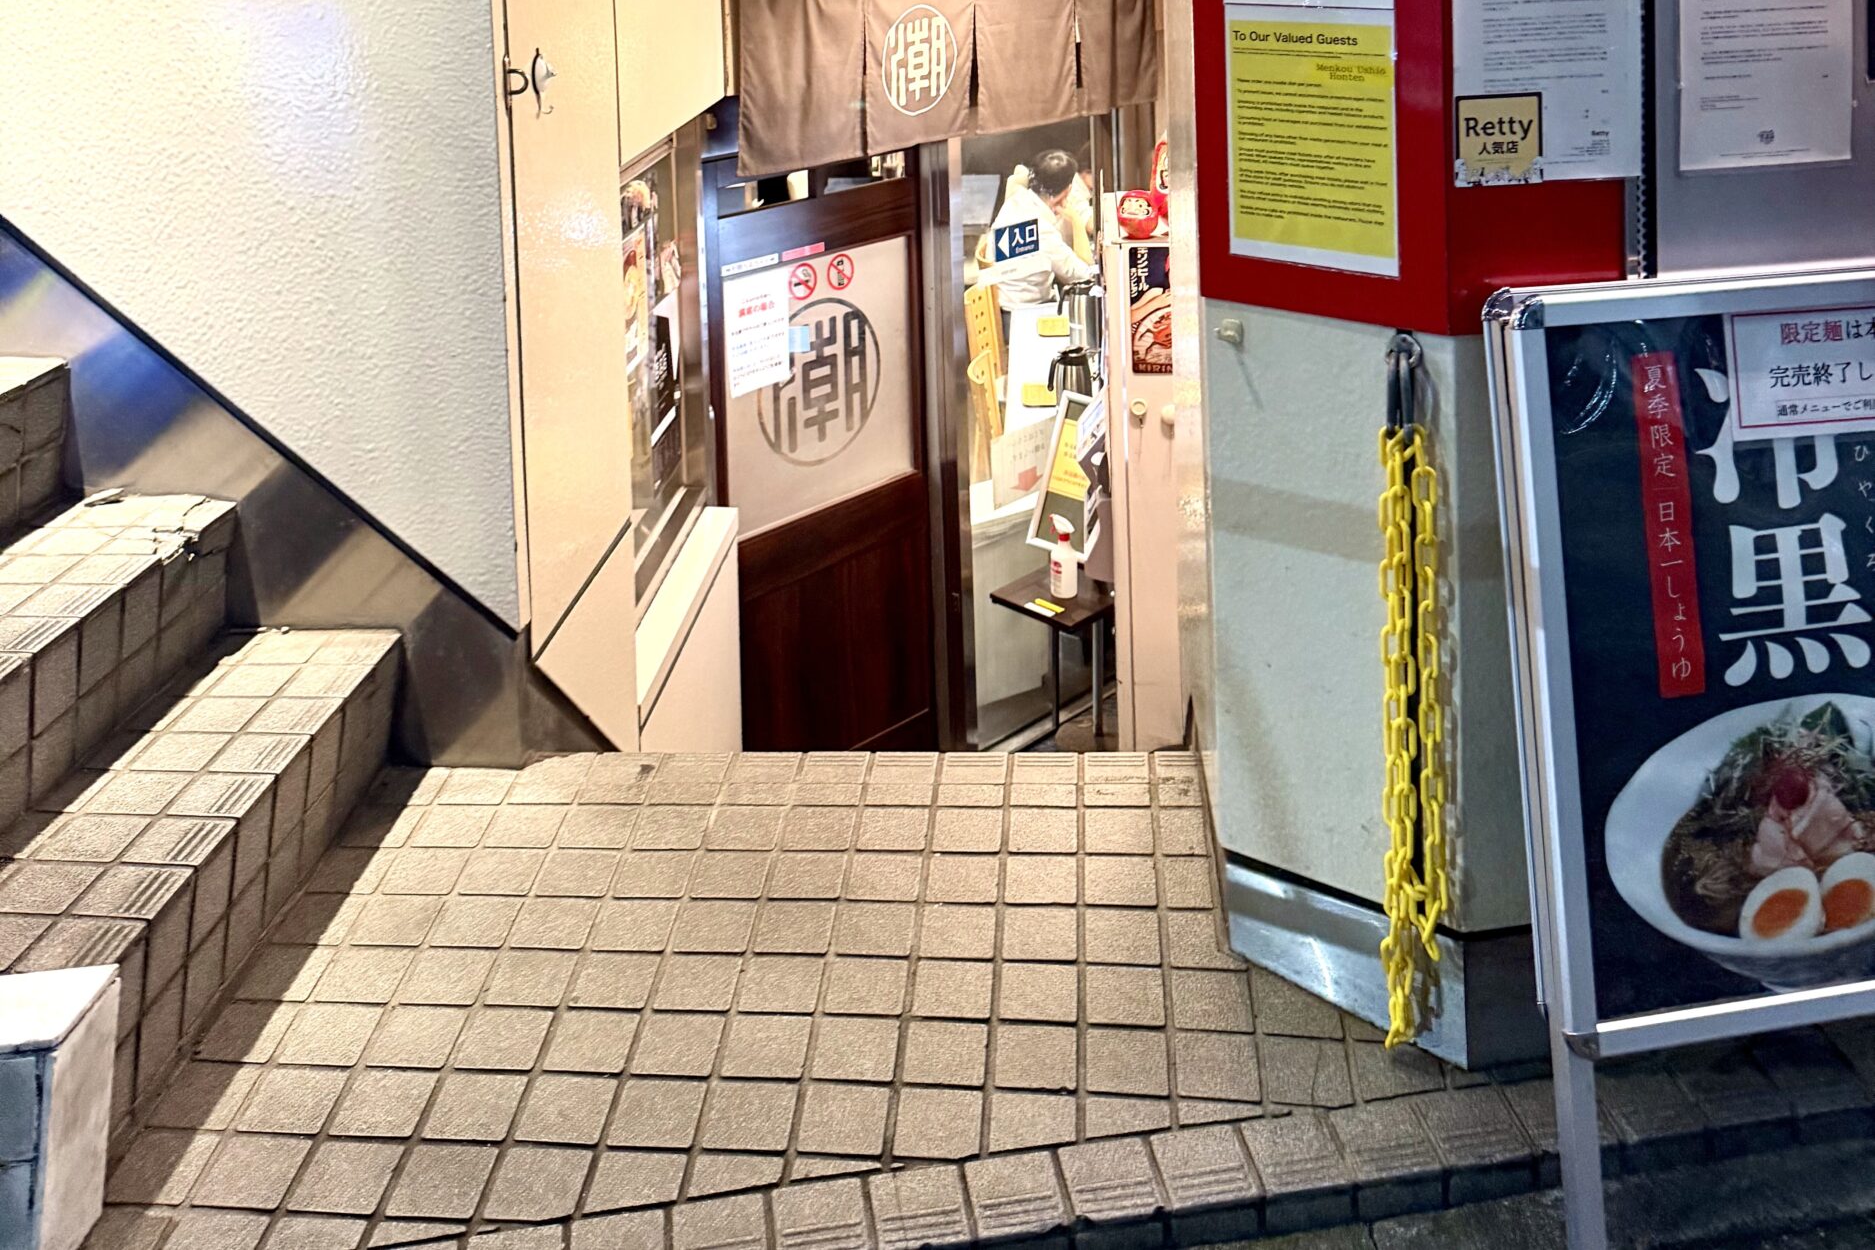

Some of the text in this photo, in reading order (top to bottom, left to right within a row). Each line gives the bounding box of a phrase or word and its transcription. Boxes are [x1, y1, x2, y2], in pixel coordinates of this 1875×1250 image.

[1232, 30, 1359, 46] To Our Valued Guests
[1464, 116, 1533, 141] Retty
[1478, 141, 1518, 156] 人気店
[1011, 224, 1037, 247] 入口
[1768, 361, 1873, 389] 完売終了し
[1643, 364, 1675, 478] 夏季限定
